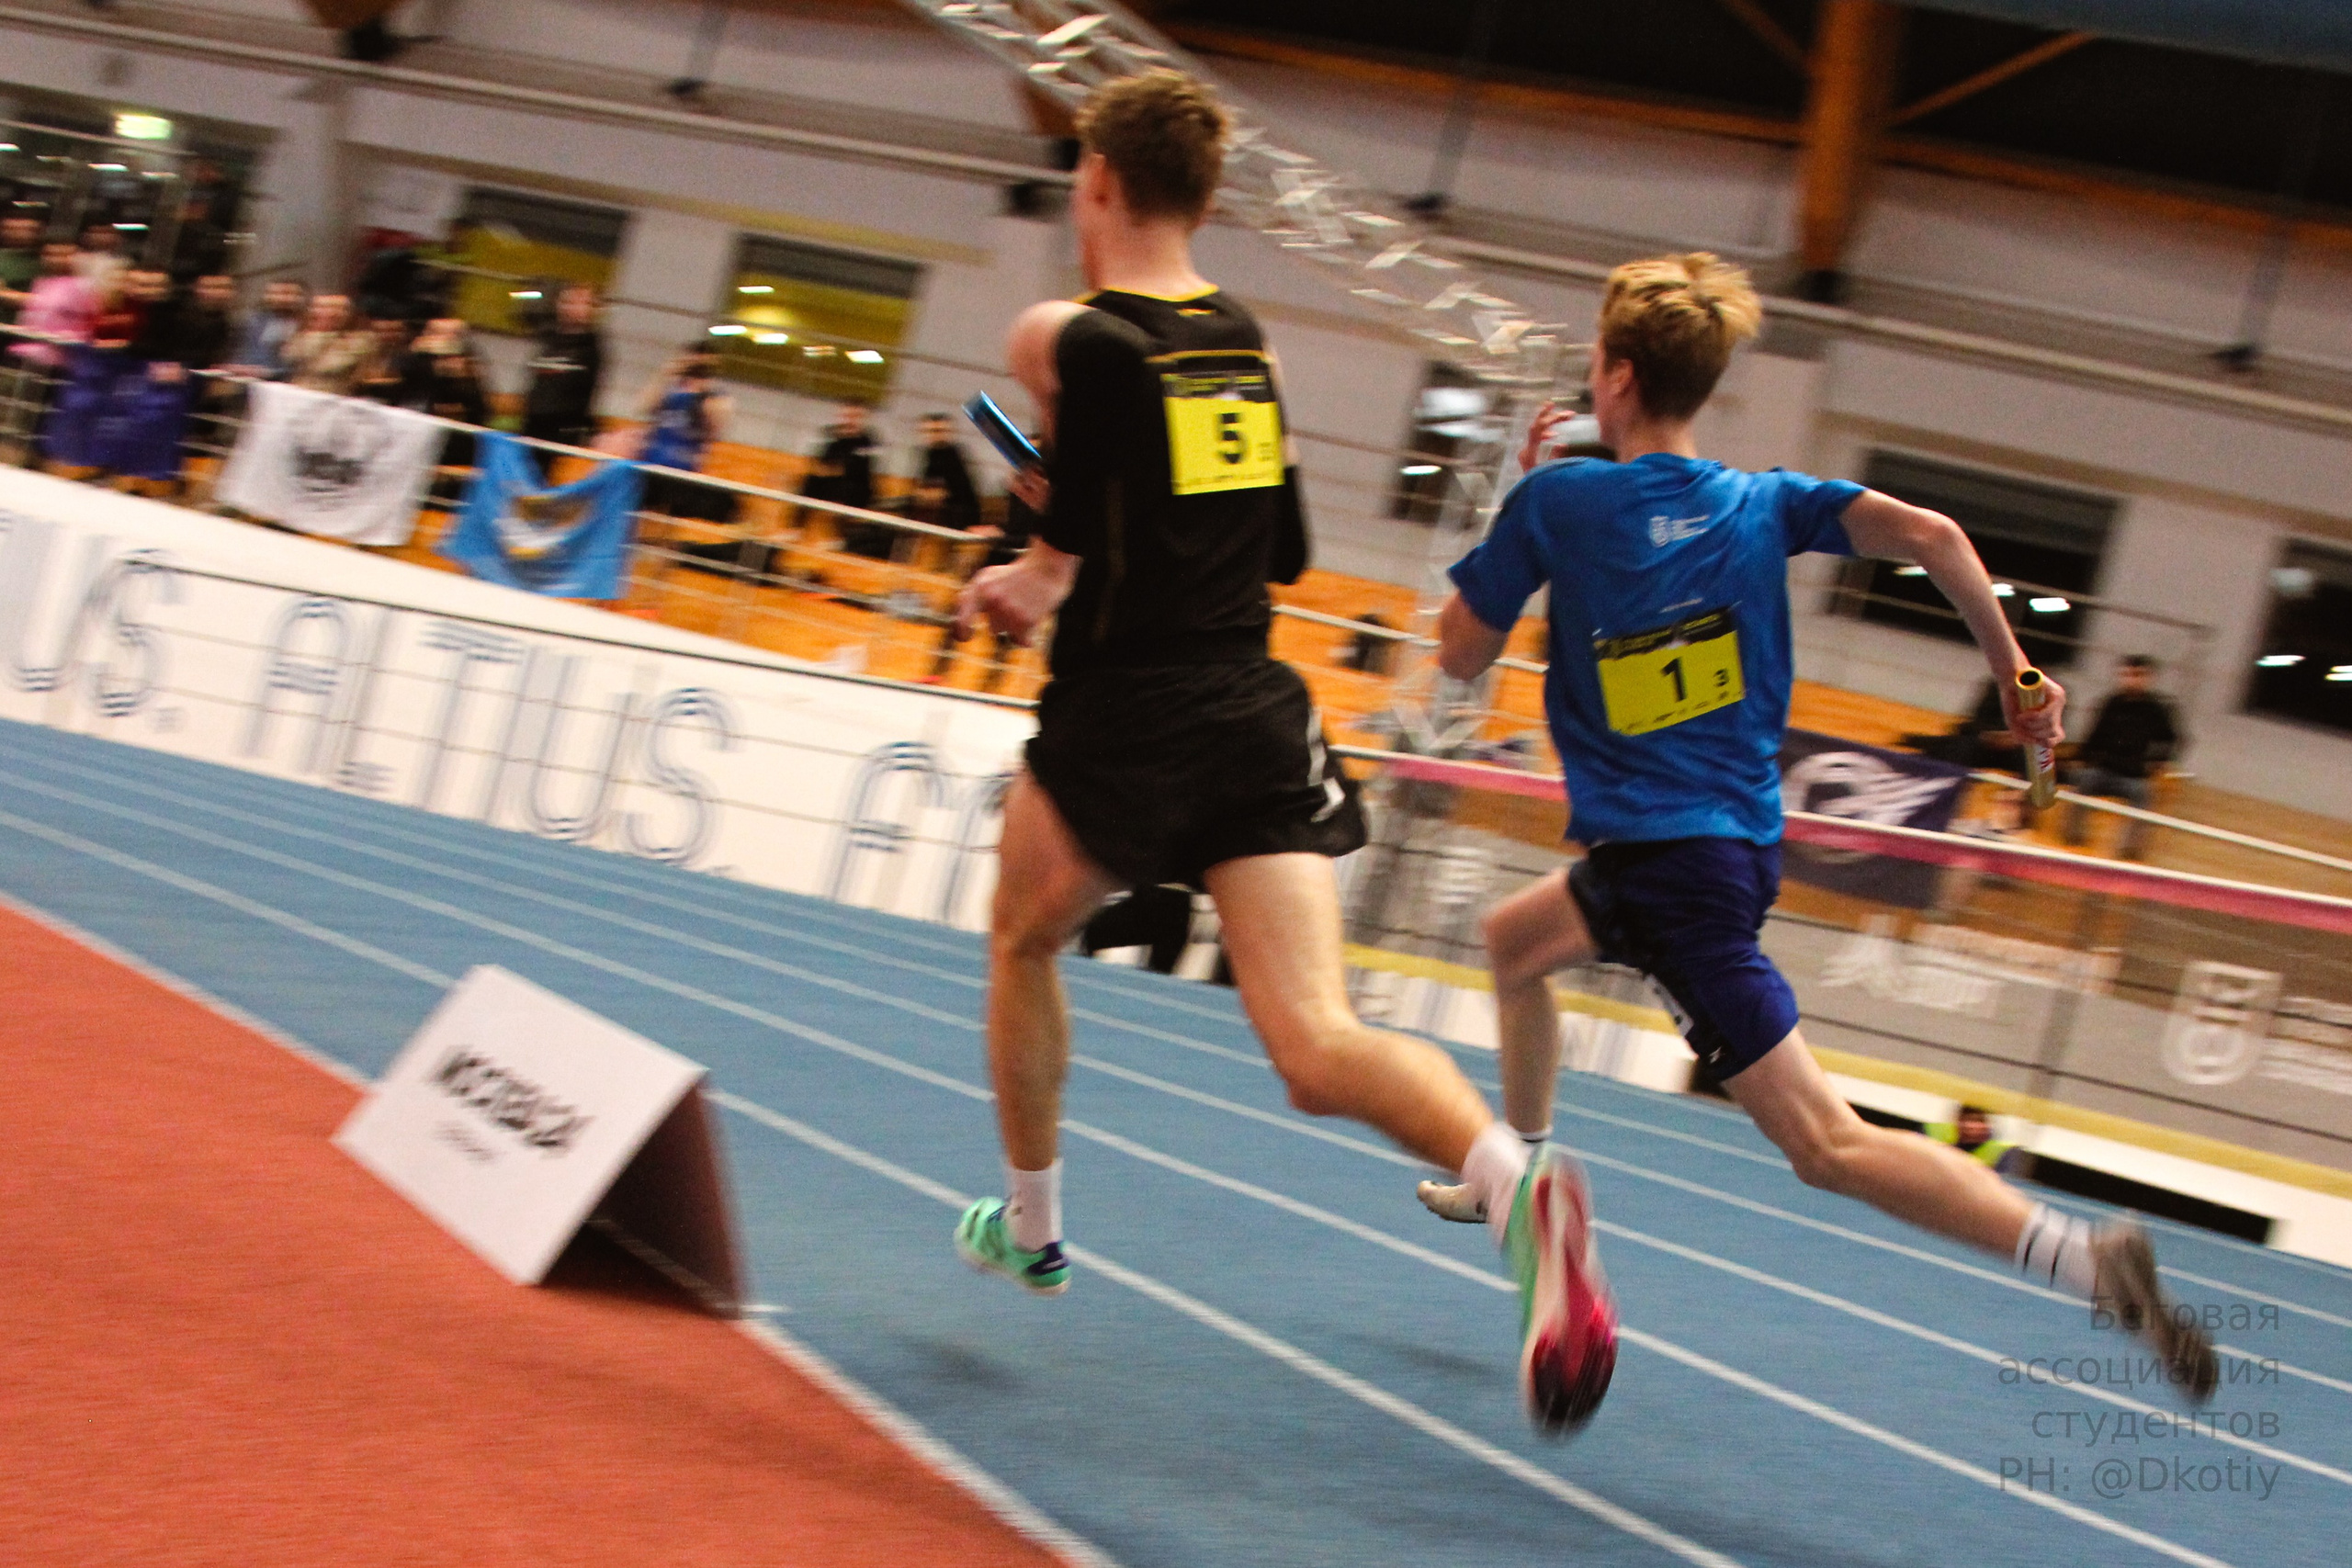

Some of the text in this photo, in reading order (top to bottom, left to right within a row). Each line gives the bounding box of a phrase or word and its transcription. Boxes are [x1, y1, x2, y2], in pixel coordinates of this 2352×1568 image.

[1216, 412, 1247, 465] 5
[1660, 656, 1730, 703] 1 3
